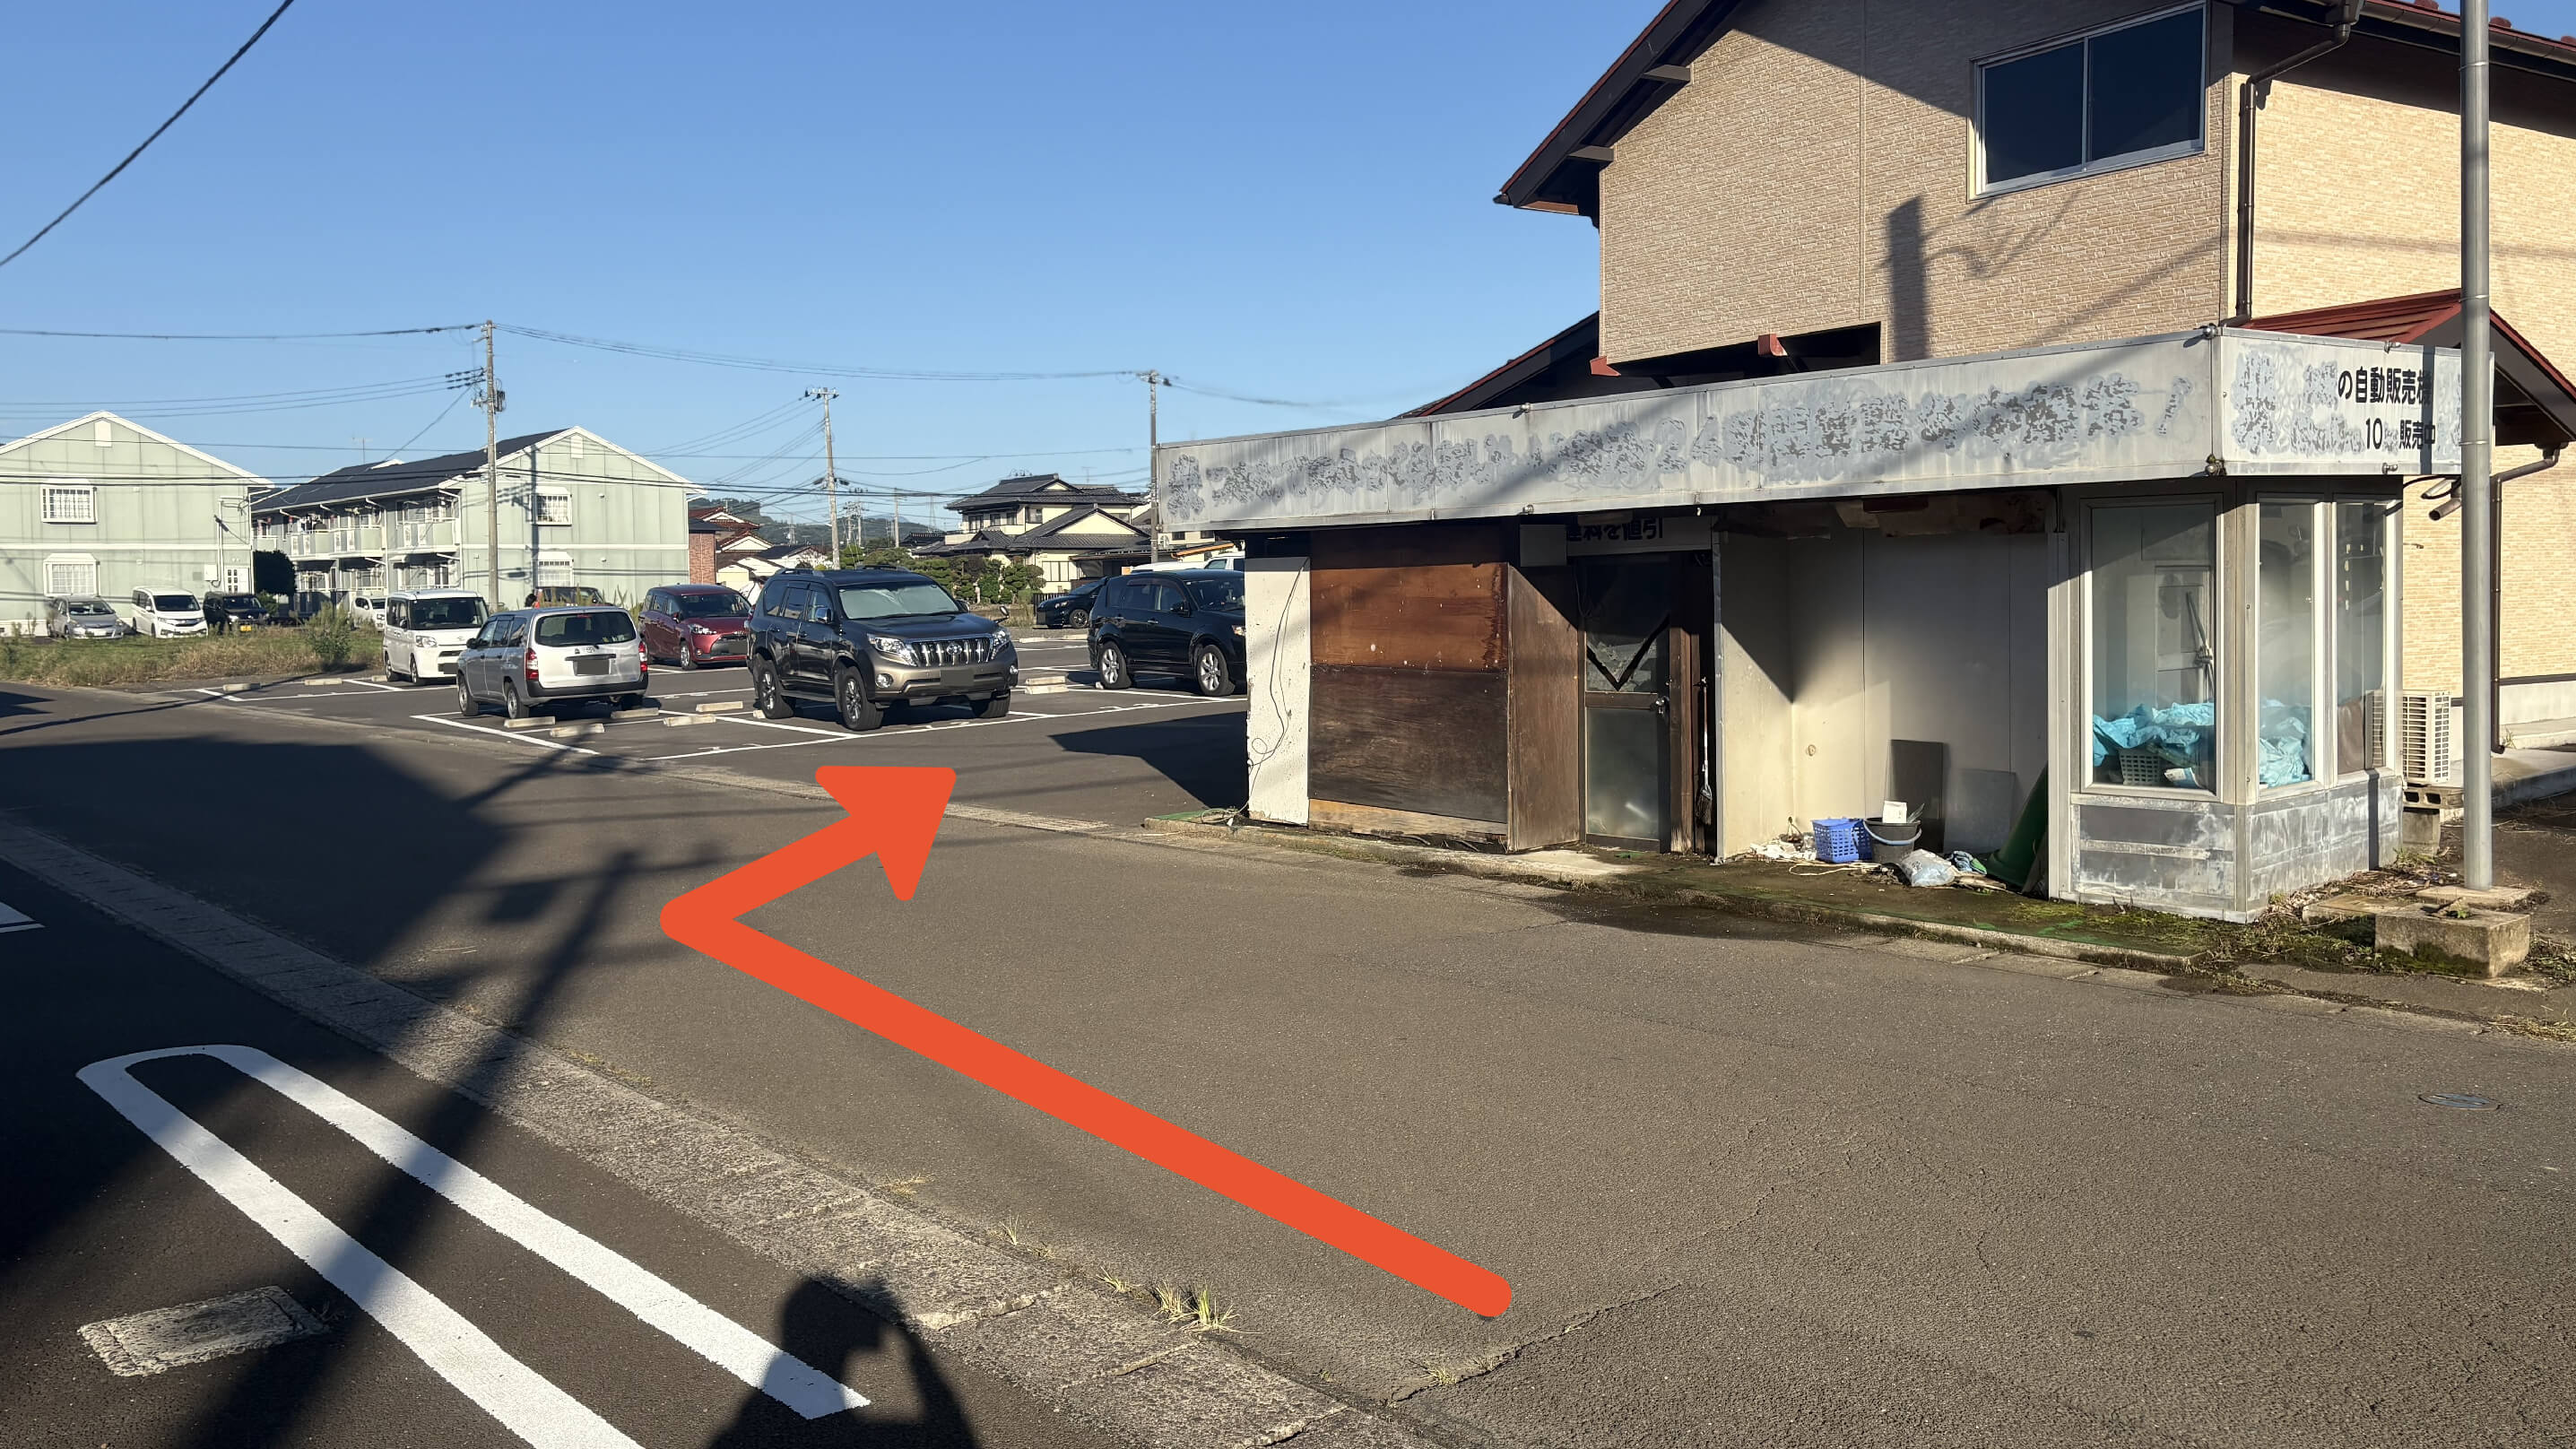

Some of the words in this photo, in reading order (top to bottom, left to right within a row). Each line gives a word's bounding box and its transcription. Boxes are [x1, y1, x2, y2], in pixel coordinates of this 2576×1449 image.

[2365, 418, 2383, 450] 10
[2398, 418, 2436, 450] 販売中
